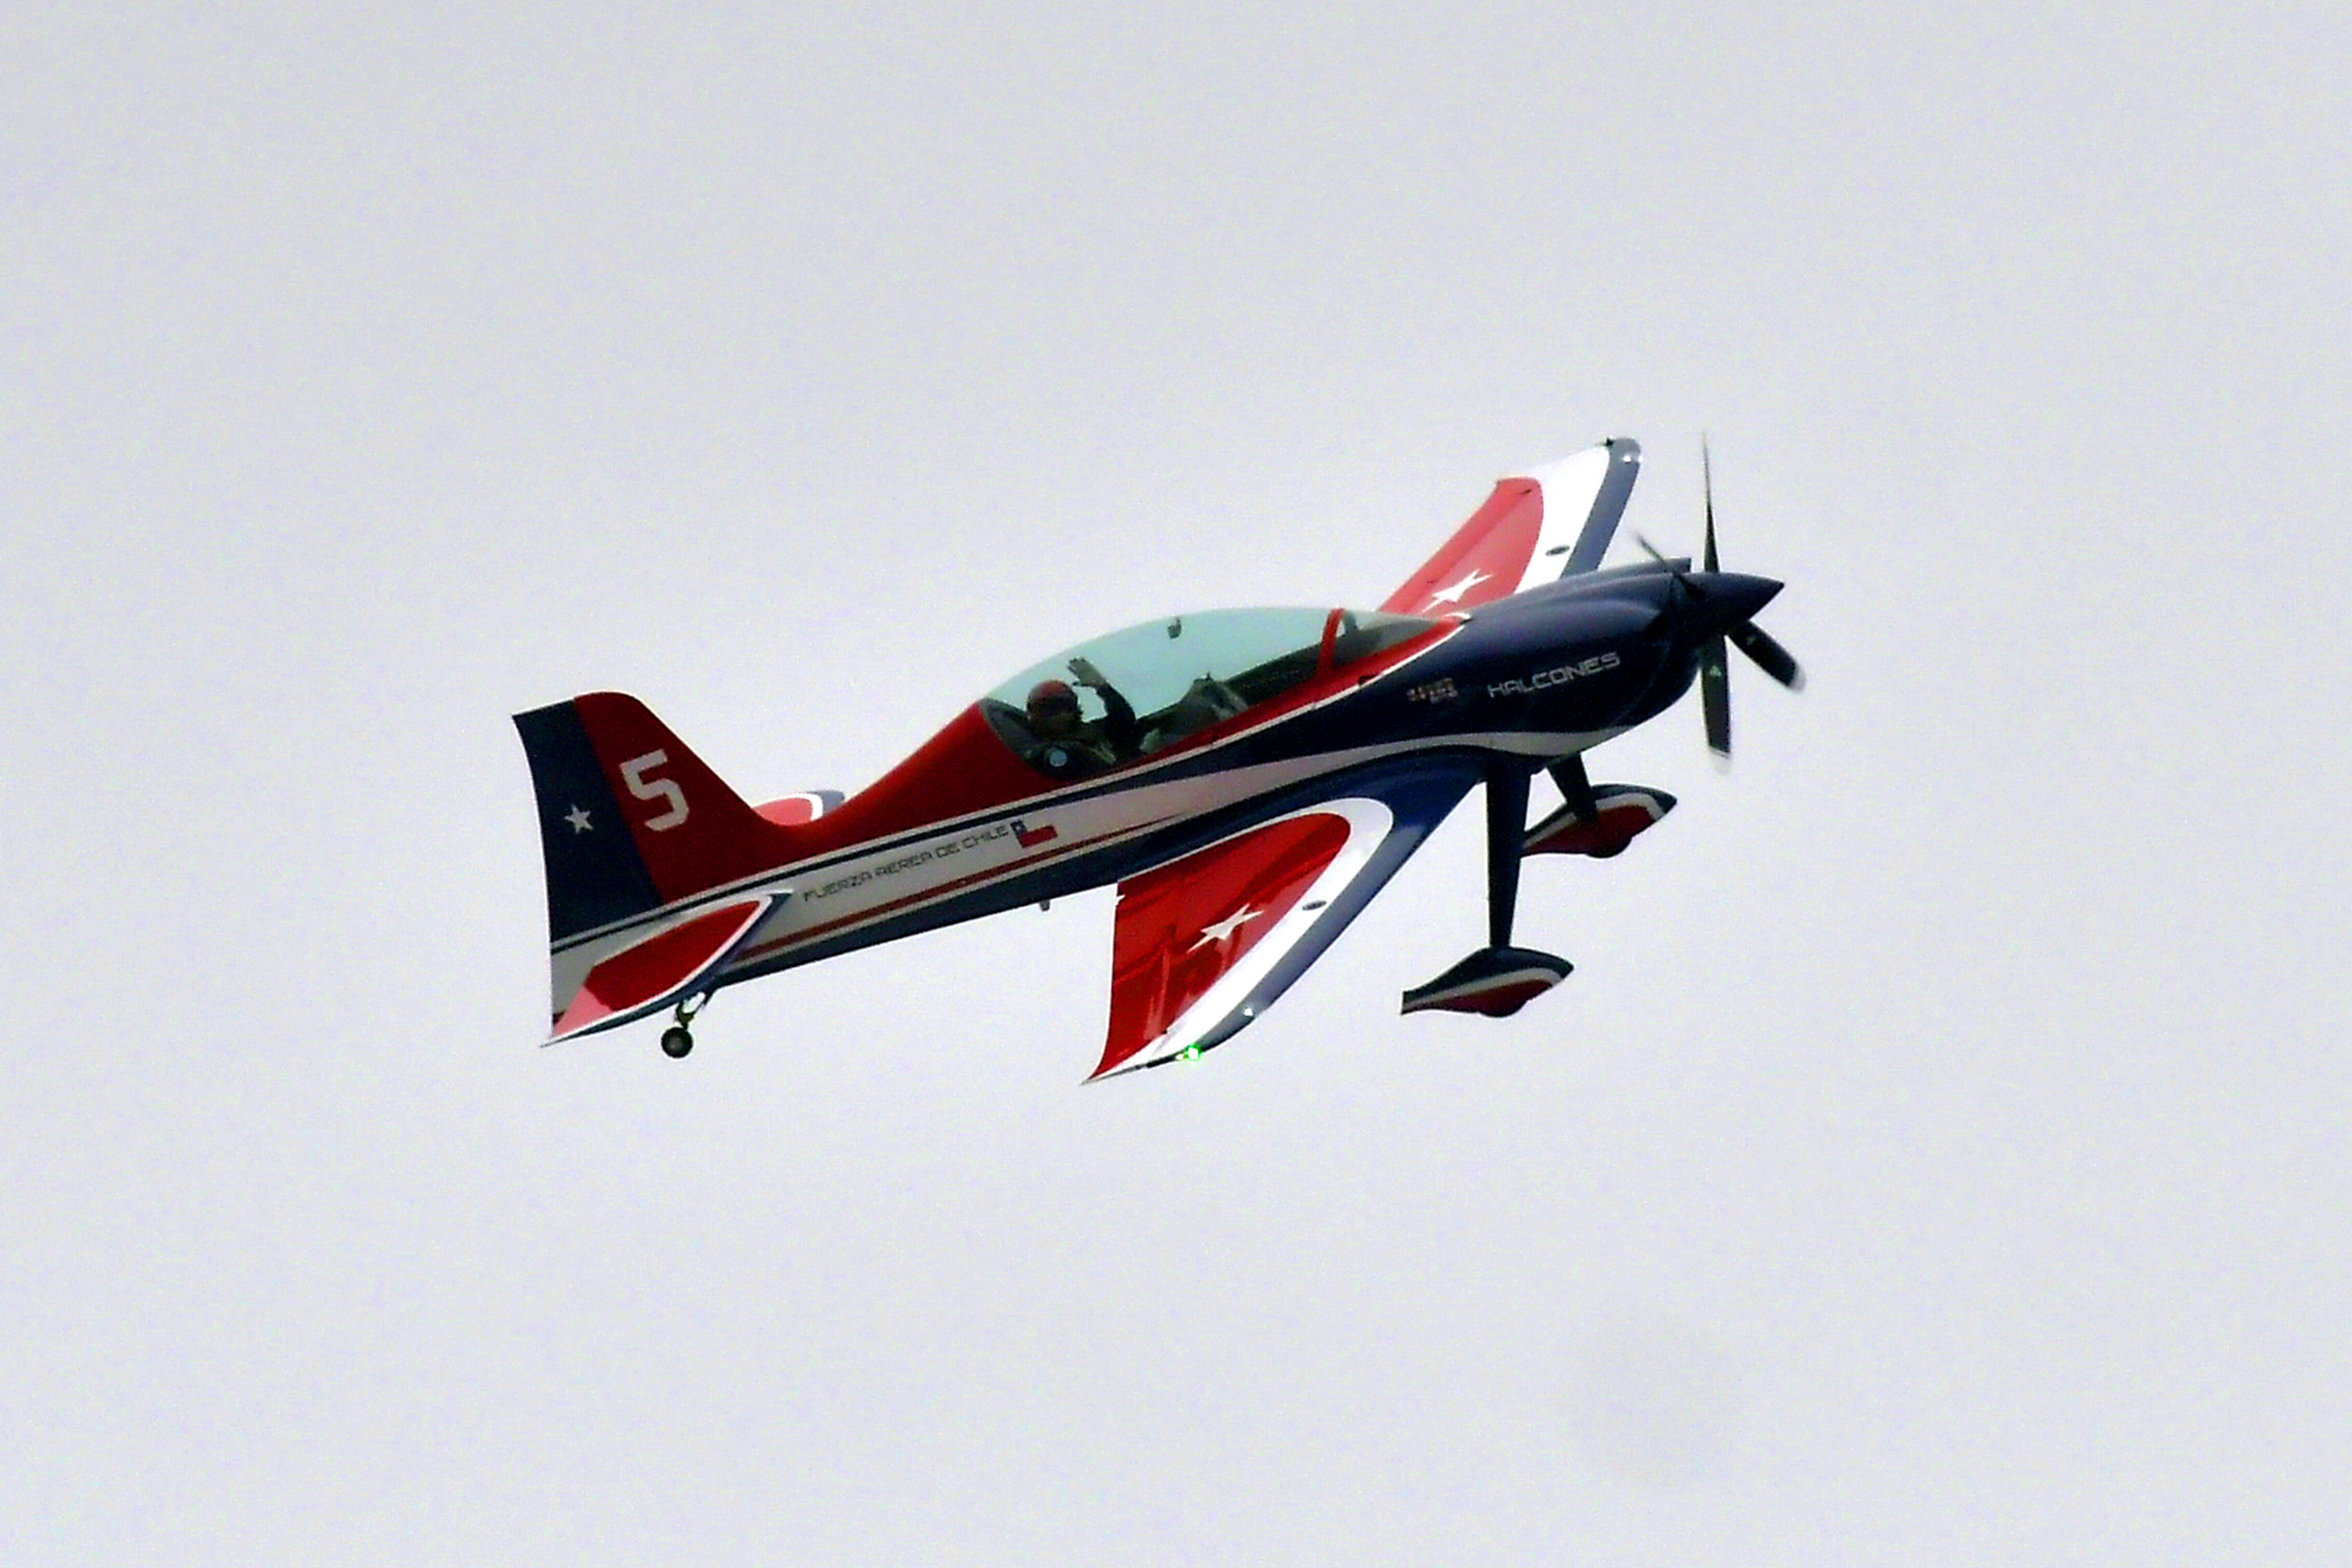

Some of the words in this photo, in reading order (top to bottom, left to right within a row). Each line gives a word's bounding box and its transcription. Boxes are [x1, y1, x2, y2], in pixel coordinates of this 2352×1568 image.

[1487, 652, 1620, 698] HALCONES
[620, 749, 689, 831] 5
[803, 871, 872, 901] FUERZA
[875, 851, 932, 876] AEREA
[936, 843, 960, 858] DE
[963, 825, 1008, 849] CHILE
